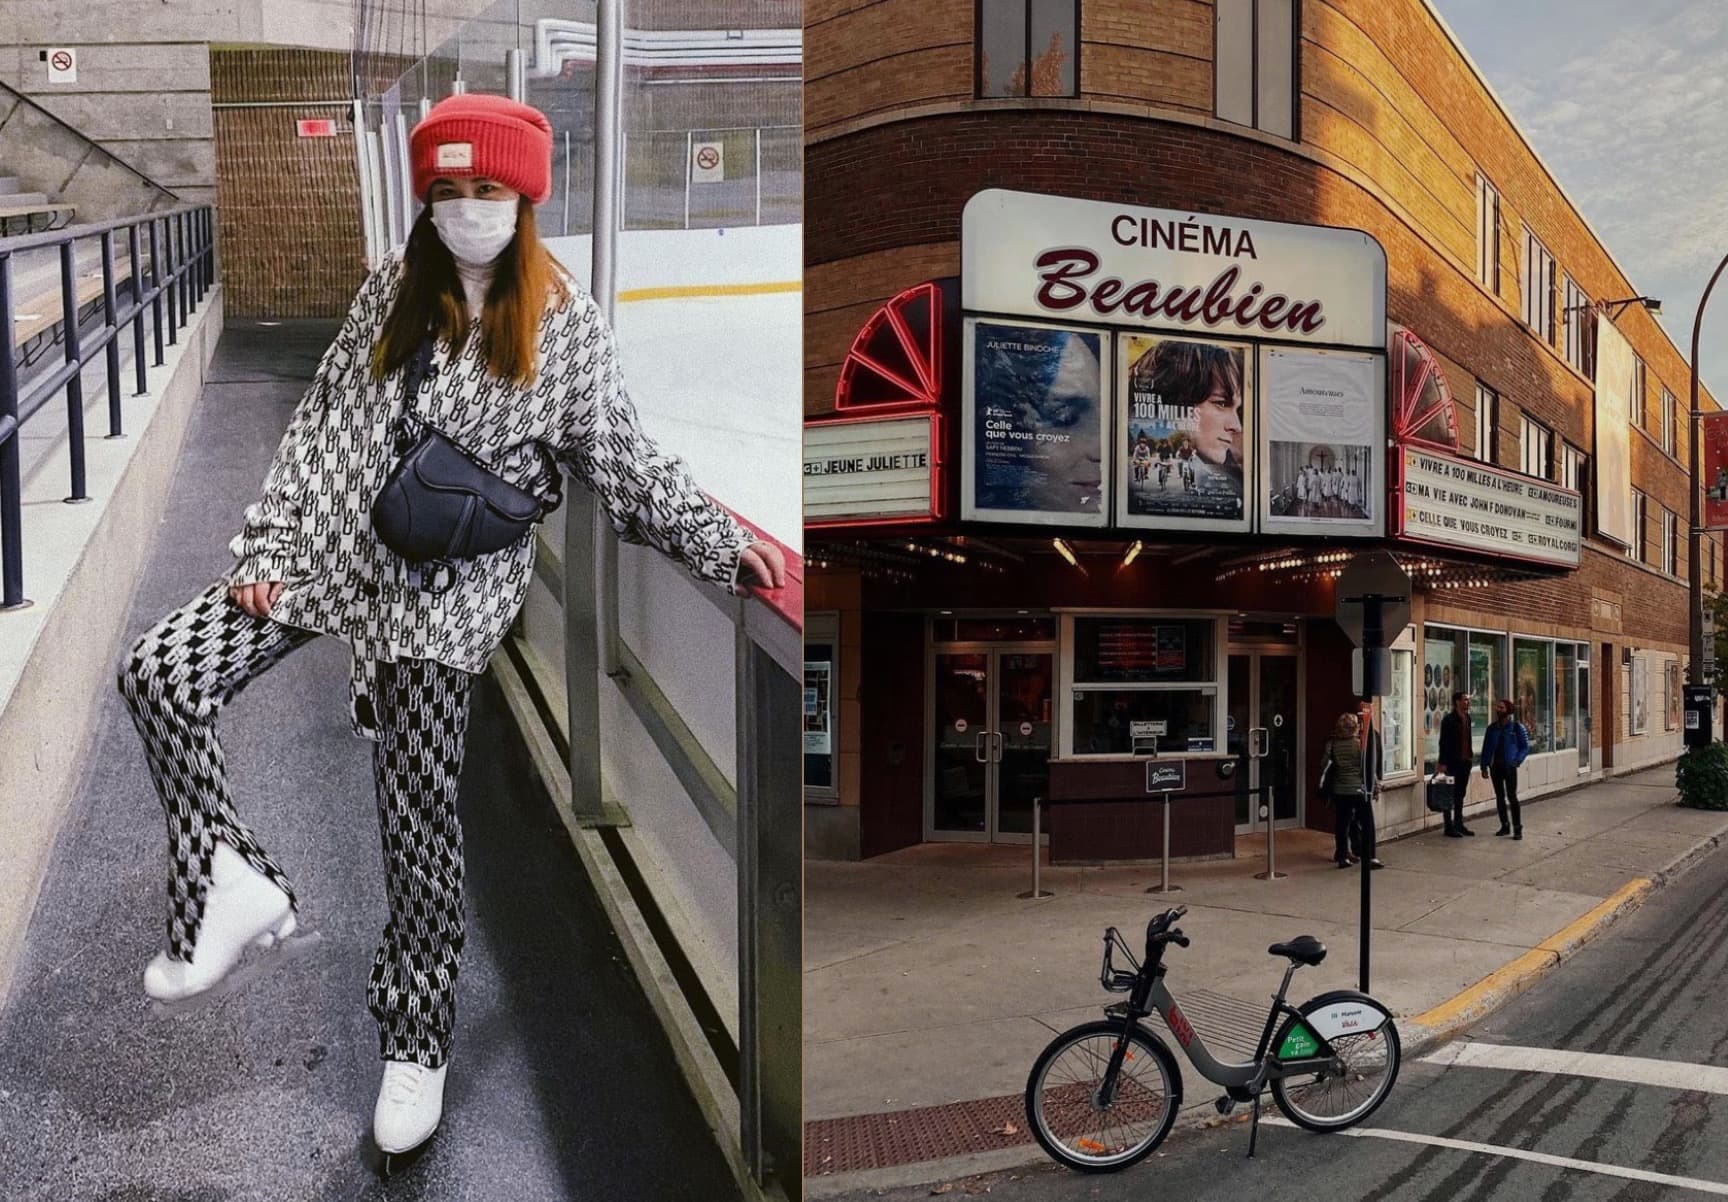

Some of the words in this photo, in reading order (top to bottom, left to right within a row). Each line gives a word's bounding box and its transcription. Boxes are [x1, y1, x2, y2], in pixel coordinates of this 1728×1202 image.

[1111, 215, 1257, 260] CINÉMA
[1034, 247, 1325, 334] Beaubien
[986, 341, 1022, 351] JULIETTE
[1023, 343, 1058, 353] BINOCHE
[1134, 392, 1156, 404] VIVRE
[1134, 403, 1156, 418] 100
[1158, 404, 1201, 421] MILLES
[985, 420, 1012, 430] Celle
[985, 430, 1006, 439] que
[1009, 431, 1033, 440] vous
[1035, 434, 1070, 442] croyez
[824, 459, 863, 474] JEUNE
[866, 454, 926, 470] JULIETTE
[1420, 457, 1443, 475] VIVRE
[1444, 465, 1450, 477] A
[1452, 467, 1465, 481] 100
[1466, 470, 1491, 487] MILLES
[1418, 484, 1430, 498] MA
[1433, 488, 1447, 502] VIE
[1449, 492, 1468, 507] AVEC
[1470, 497, 1488, 512] JOHN
[1419, 511, 1441, 527] CELLE
[1443, 516, 1457, 529] QUE
[1460, 519, 1479, 533] VOUS
[1480, 523, 1508, 539] CROYEZ
